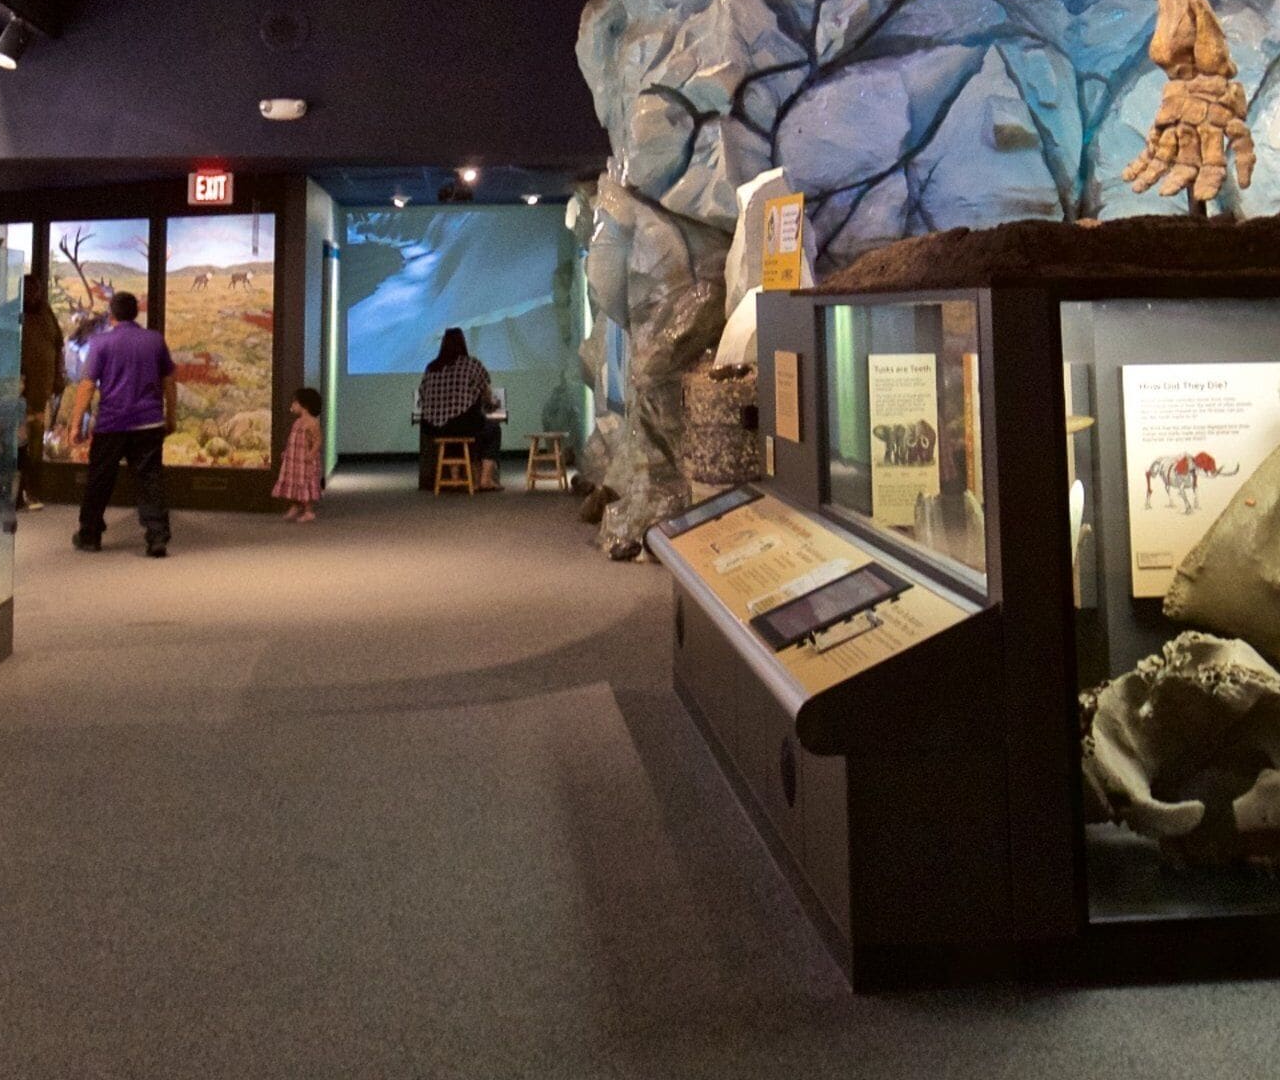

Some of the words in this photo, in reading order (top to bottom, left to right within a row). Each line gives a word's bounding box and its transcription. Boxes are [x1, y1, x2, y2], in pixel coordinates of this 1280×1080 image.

[196, 175, 227, 201] EXIT
[910, 364, 932, 373] Teeth
[1139, 381, 1161, 391] How
[1163, 381, 1180, 390] Did
[1183, 381, 1205, 392] They
[1207, 380, 1229, 390] Die?
